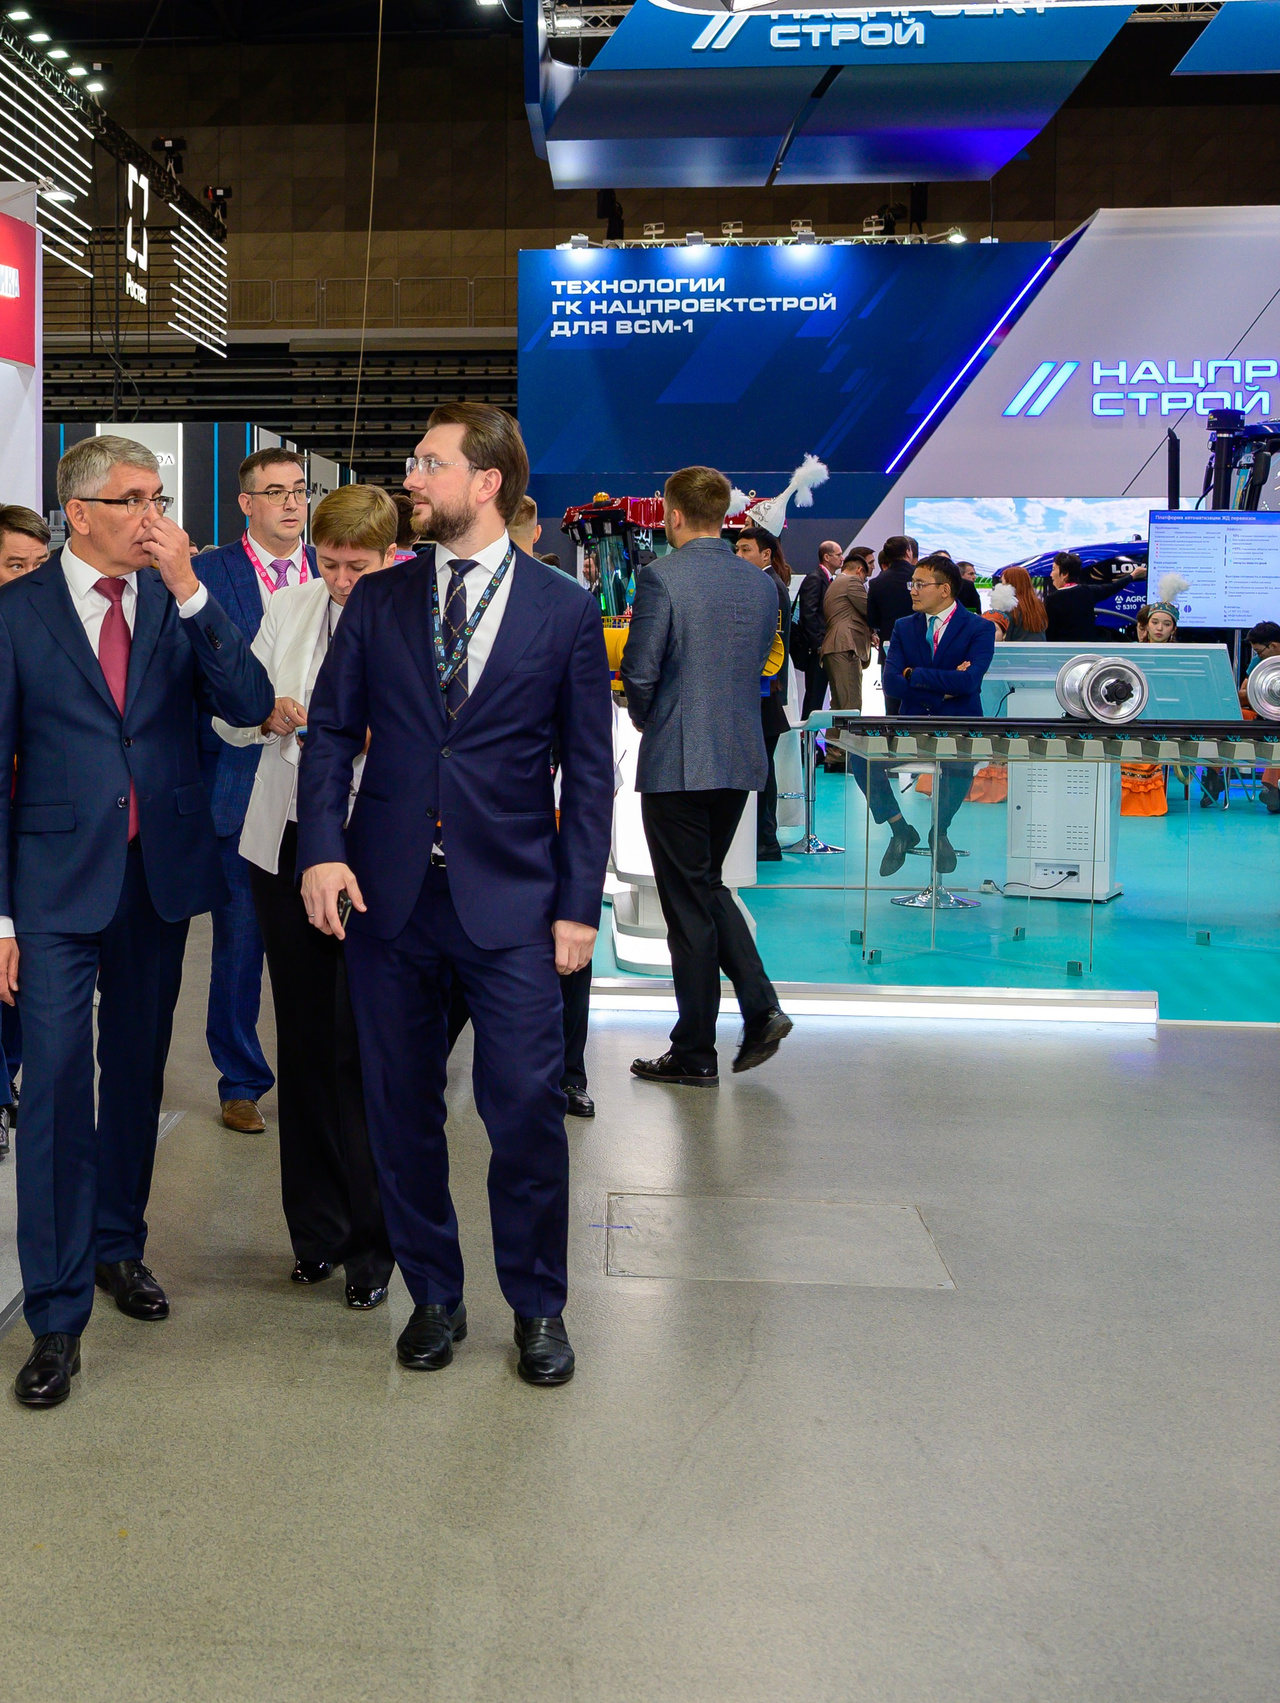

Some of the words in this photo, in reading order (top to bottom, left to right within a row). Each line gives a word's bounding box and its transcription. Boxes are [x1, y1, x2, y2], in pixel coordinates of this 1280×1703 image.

[770, 18, 926, 49] СТРОЙ
[551, 278, 725, 294] ТЕХНОЛОГИИ
[551, 300, 584, 315] ГК
[590, 293, 837, 316] НАЦПРОЕКТСТРОЙ
[550, 320, 608, 337] ДЛЯ
[615, 319, 694, 335] ВСМ-1
[1091, 385, 1271, 416] СТРОЙ
